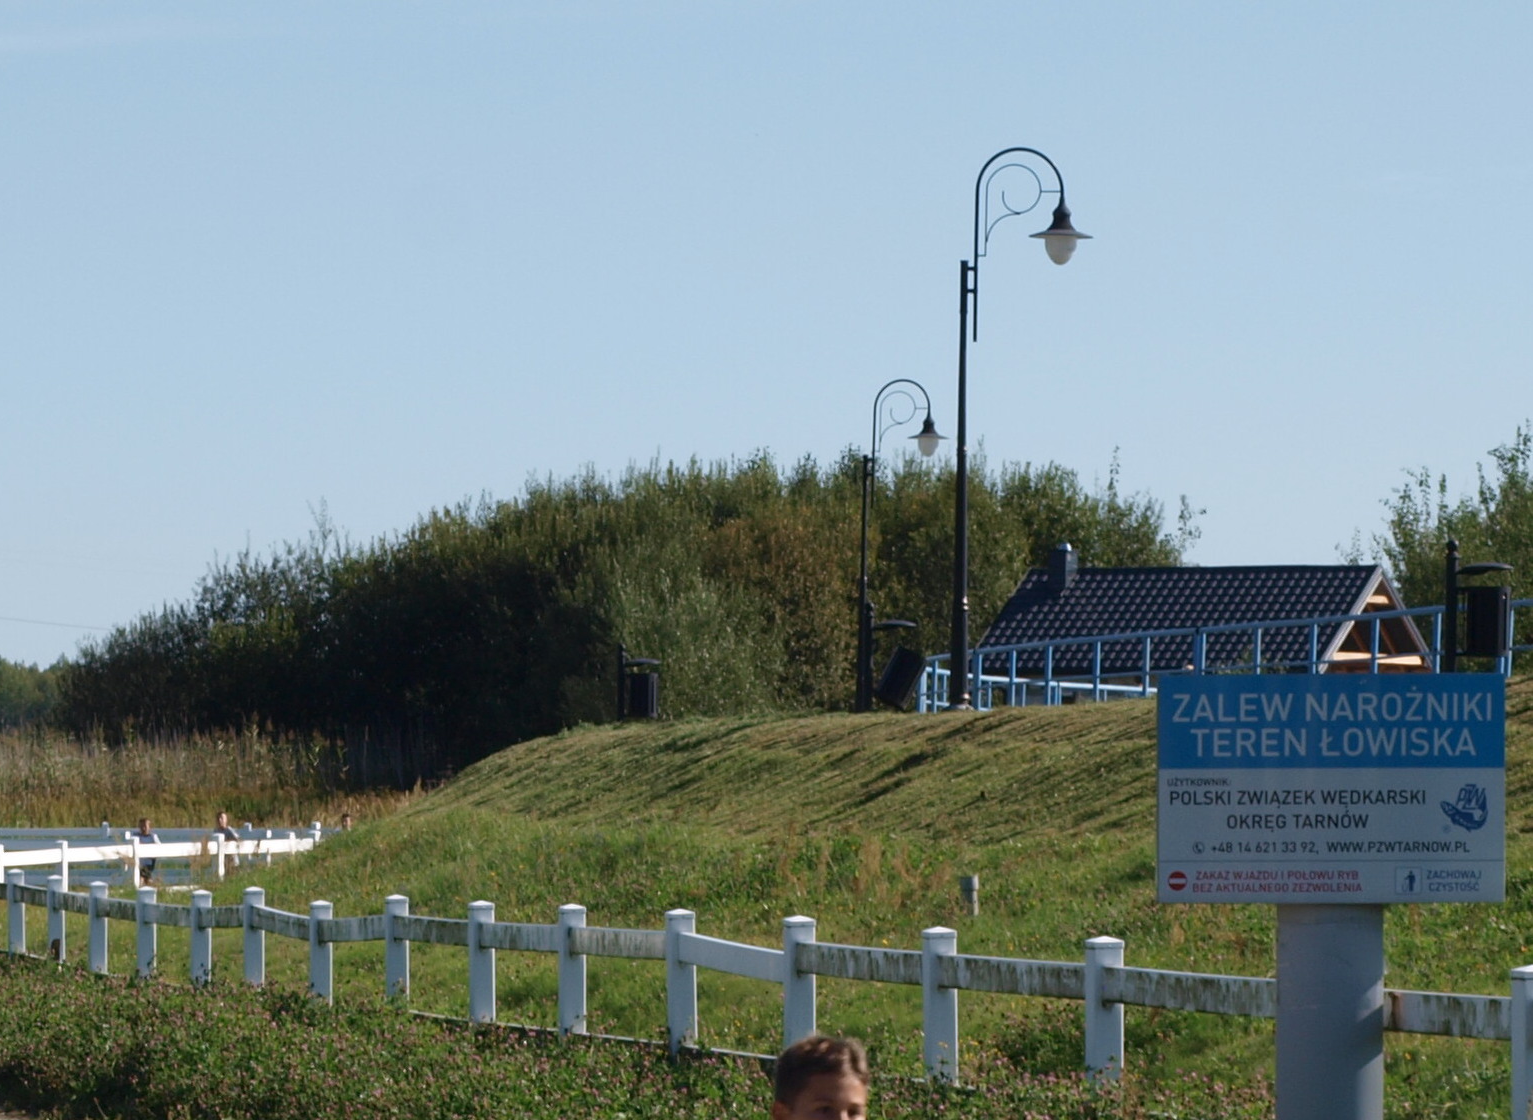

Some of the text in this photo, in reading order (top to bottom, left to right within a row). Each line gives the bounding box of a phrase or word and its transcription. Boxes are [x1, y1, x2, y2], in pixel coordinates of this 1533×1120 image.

[1172, 685, 1493, 723] ZALEW NAROŻNIKI
[1191, 727, 1477, 758] TEREN ŁOWISKA
[1169, 789, 1426, 808] POLSKI ZWIĄZEK WĘDKARSKI
[1226, 810, 1369, 832] OKRĘG TARNÓW
[1210, 841, 1233, 854] +48
[1238, 841, 1252, 854] 14
[1255, 841, 1277, 854] 621
[1282, 841, 1298, 854] 33
[1326, 840, 1470, 854] WWW.PZWTARNOW.PL
[1195, 871, 1230, 881] ZAKAZ
[1232, 871, 1278, 881] WJAZDU
[1337, 870, 1359, 880] RYB
[1426, 869, 1482, 880] ZACHOWAJ
[1192, 882, 1363, 893] BEZ AKTUALNEGO ZEZWOLENIA
